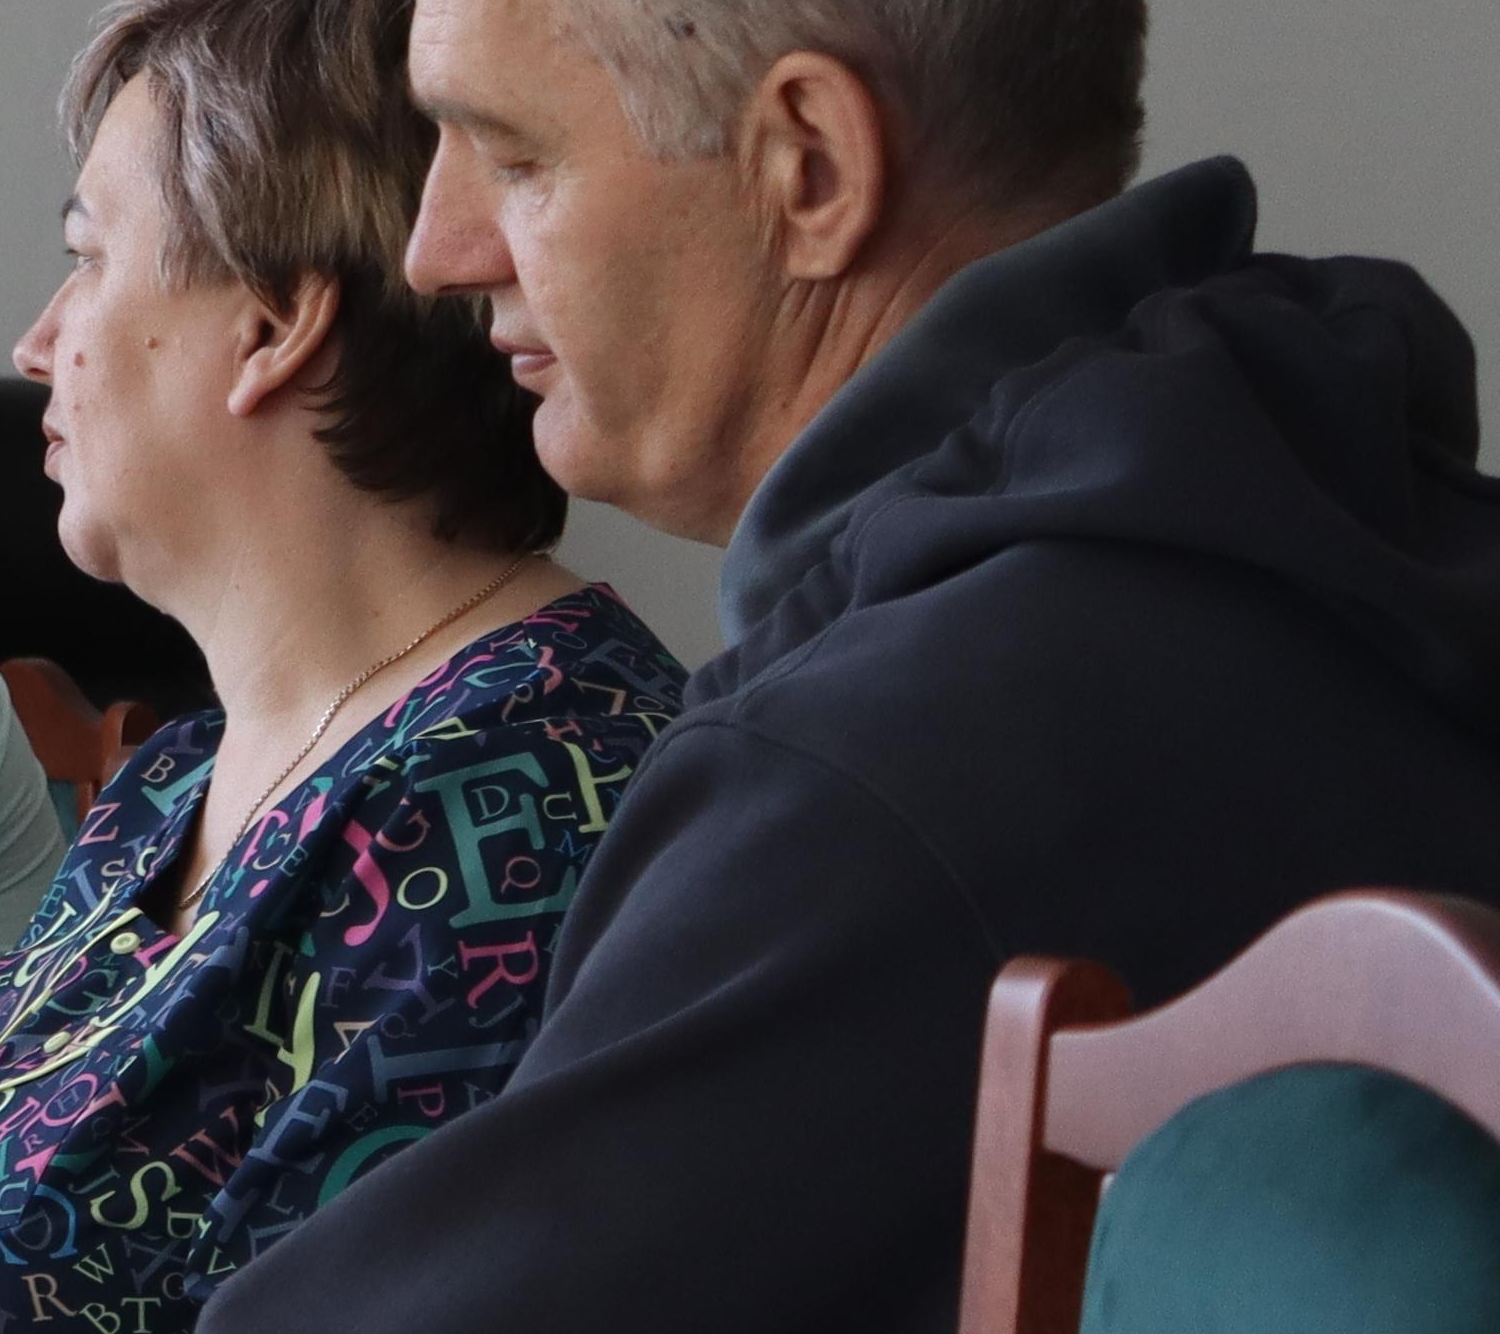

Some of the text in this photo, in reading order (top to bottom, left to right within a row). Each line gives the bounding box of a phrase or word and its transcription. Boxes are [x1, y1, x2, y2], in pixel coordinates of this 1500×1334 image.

[140, 753, 176, 783] B
[470, 785, 509, 821] D
[77, 803, 122, 846] Z
[414, 751, 578, 929] E
[397, 866, 449, 910] O
[500, 856, 541, 894] Q
[458, 930, 540, 1009] R
[397, 1082, 446, 1117] P
[90, 1160, 183, 1230] S
[73, 1243, 116, 1284] W
[21, 1273, 79, 1322] R
[120, 1297, 162, 1334] T
